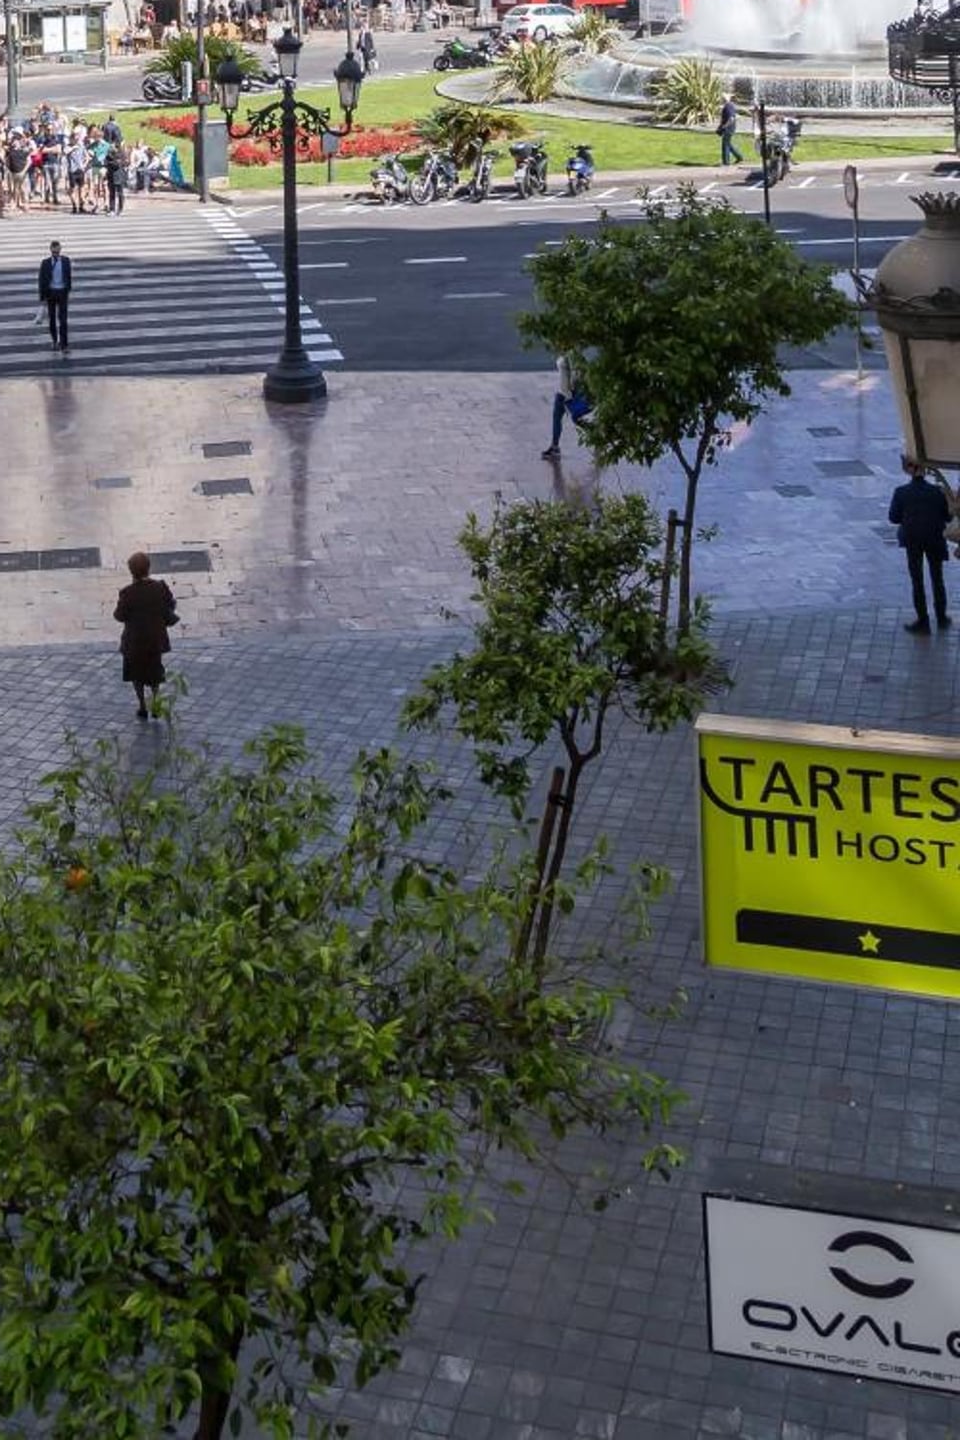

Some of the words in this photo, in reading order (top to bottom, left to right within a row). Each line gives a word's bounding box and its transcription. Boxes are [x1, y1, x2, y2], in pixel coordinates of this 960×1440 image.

[718, 756, 960, 822] TARTES
[836, 829, 960, 870] HOST
[750, 1340, 869, 1368] ELECTRONIC
